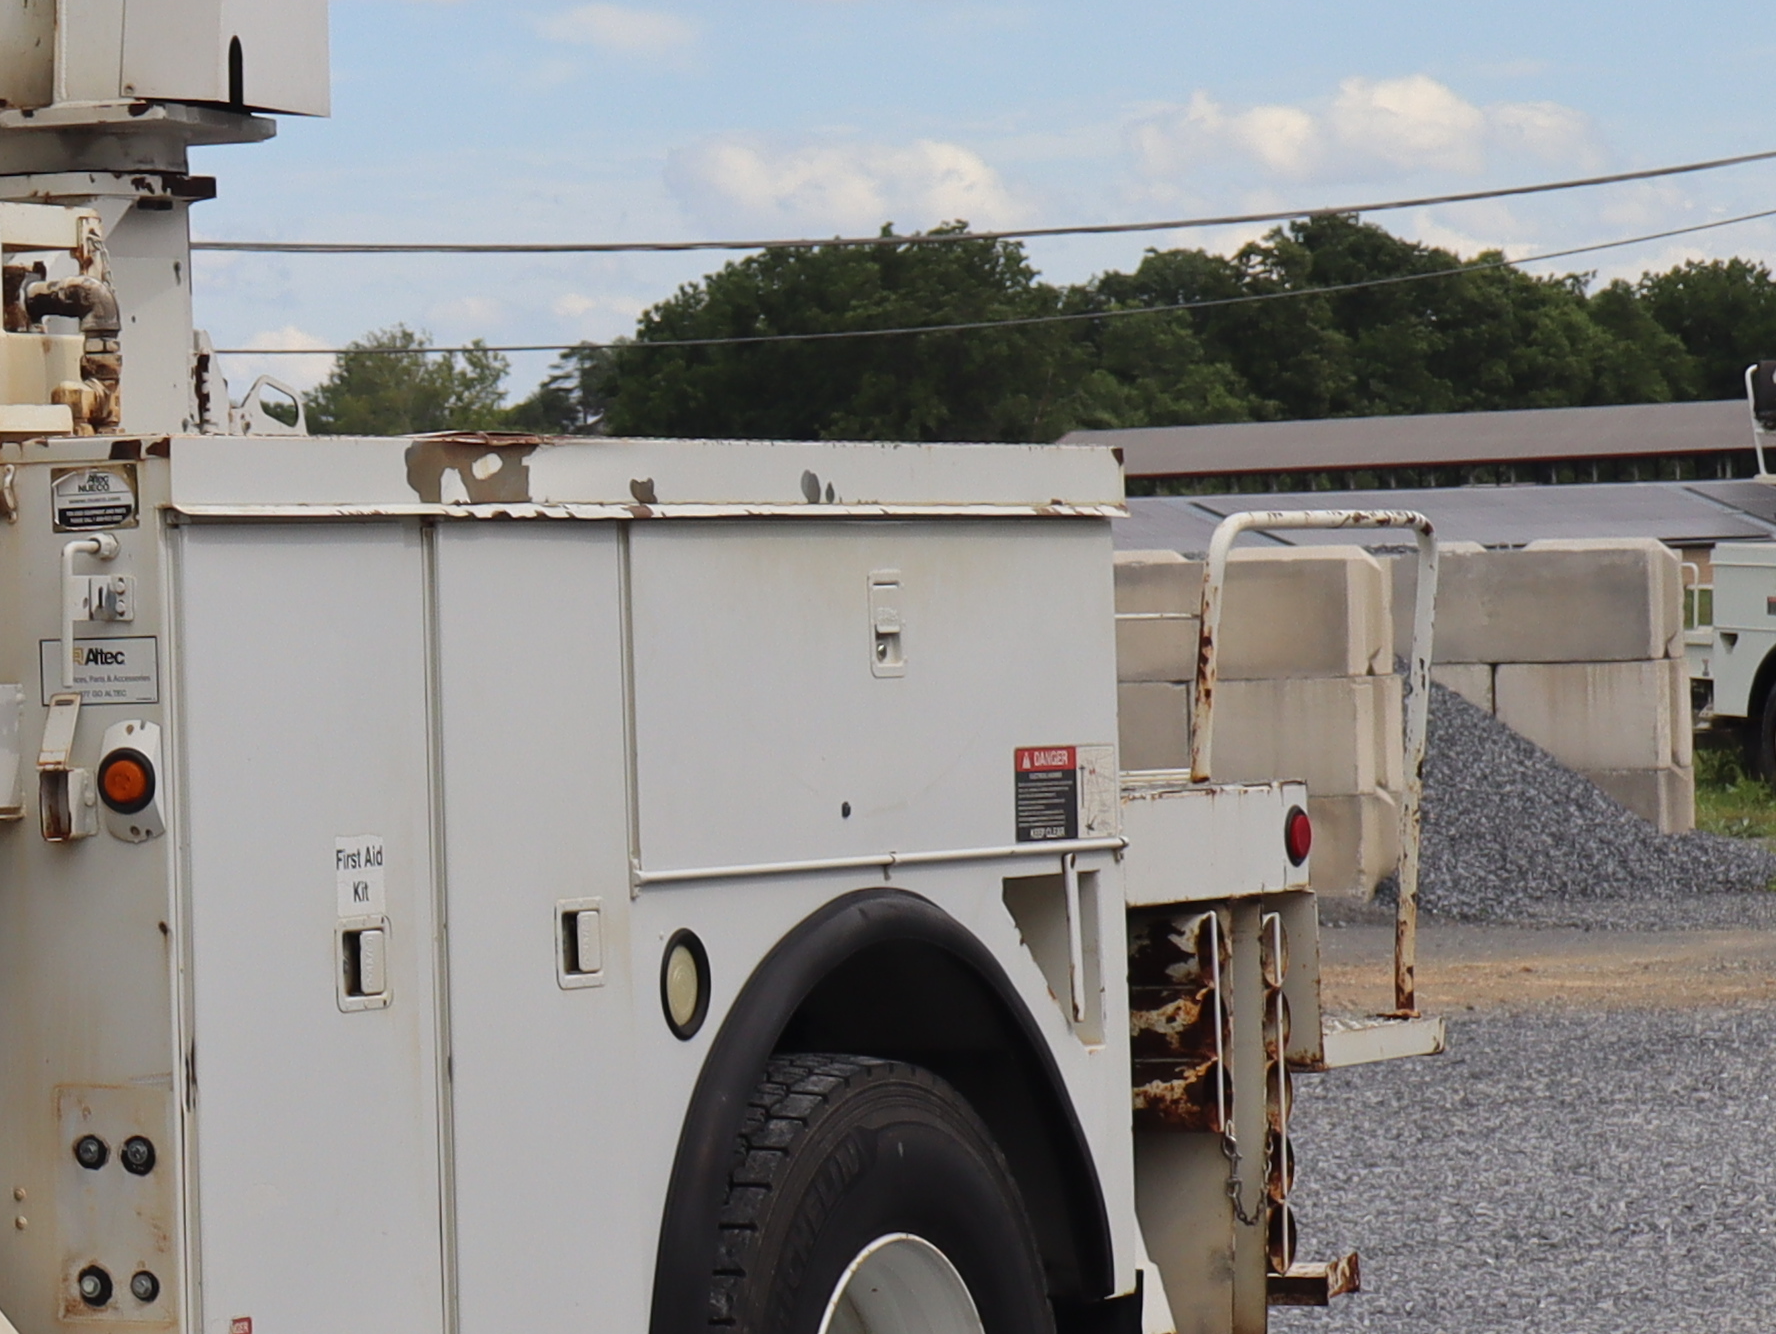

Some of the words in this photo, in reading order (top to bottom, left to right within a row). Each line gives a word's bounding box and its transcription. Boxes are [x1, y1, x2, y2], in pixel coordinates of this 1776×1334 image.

[85, 648, 125, 665] Altec
[1033, 750, 1068, 766] DANGER
[336, 849, 362, 870] First
[365, 845, 383, 867] Aid
[353, 881, 369, 902] Kit
